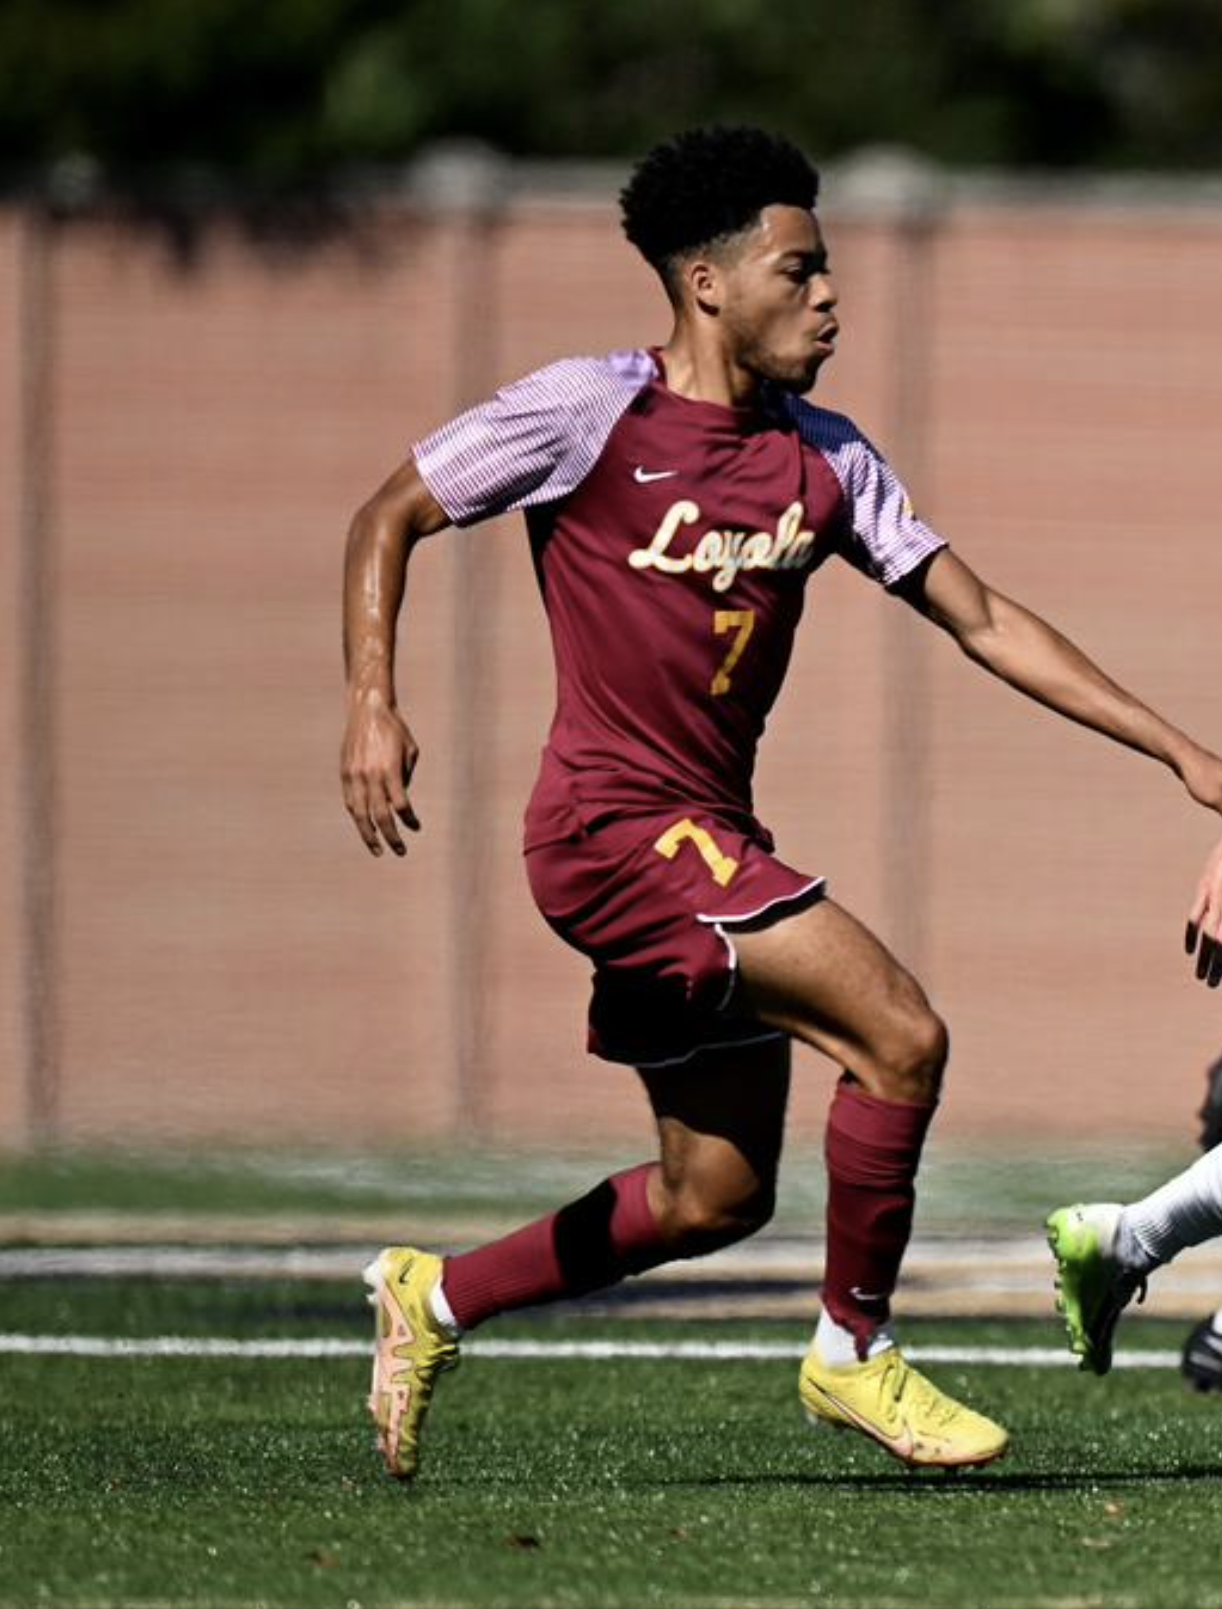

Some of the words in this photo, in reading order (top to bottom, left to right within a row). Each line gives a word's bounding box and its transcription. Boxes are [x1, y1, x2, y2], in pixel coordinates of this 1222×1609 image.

[628, 500, 815, 593] Loyola
[710, 609, 755, 695] 7
[653, 817, 739, 888] 7
